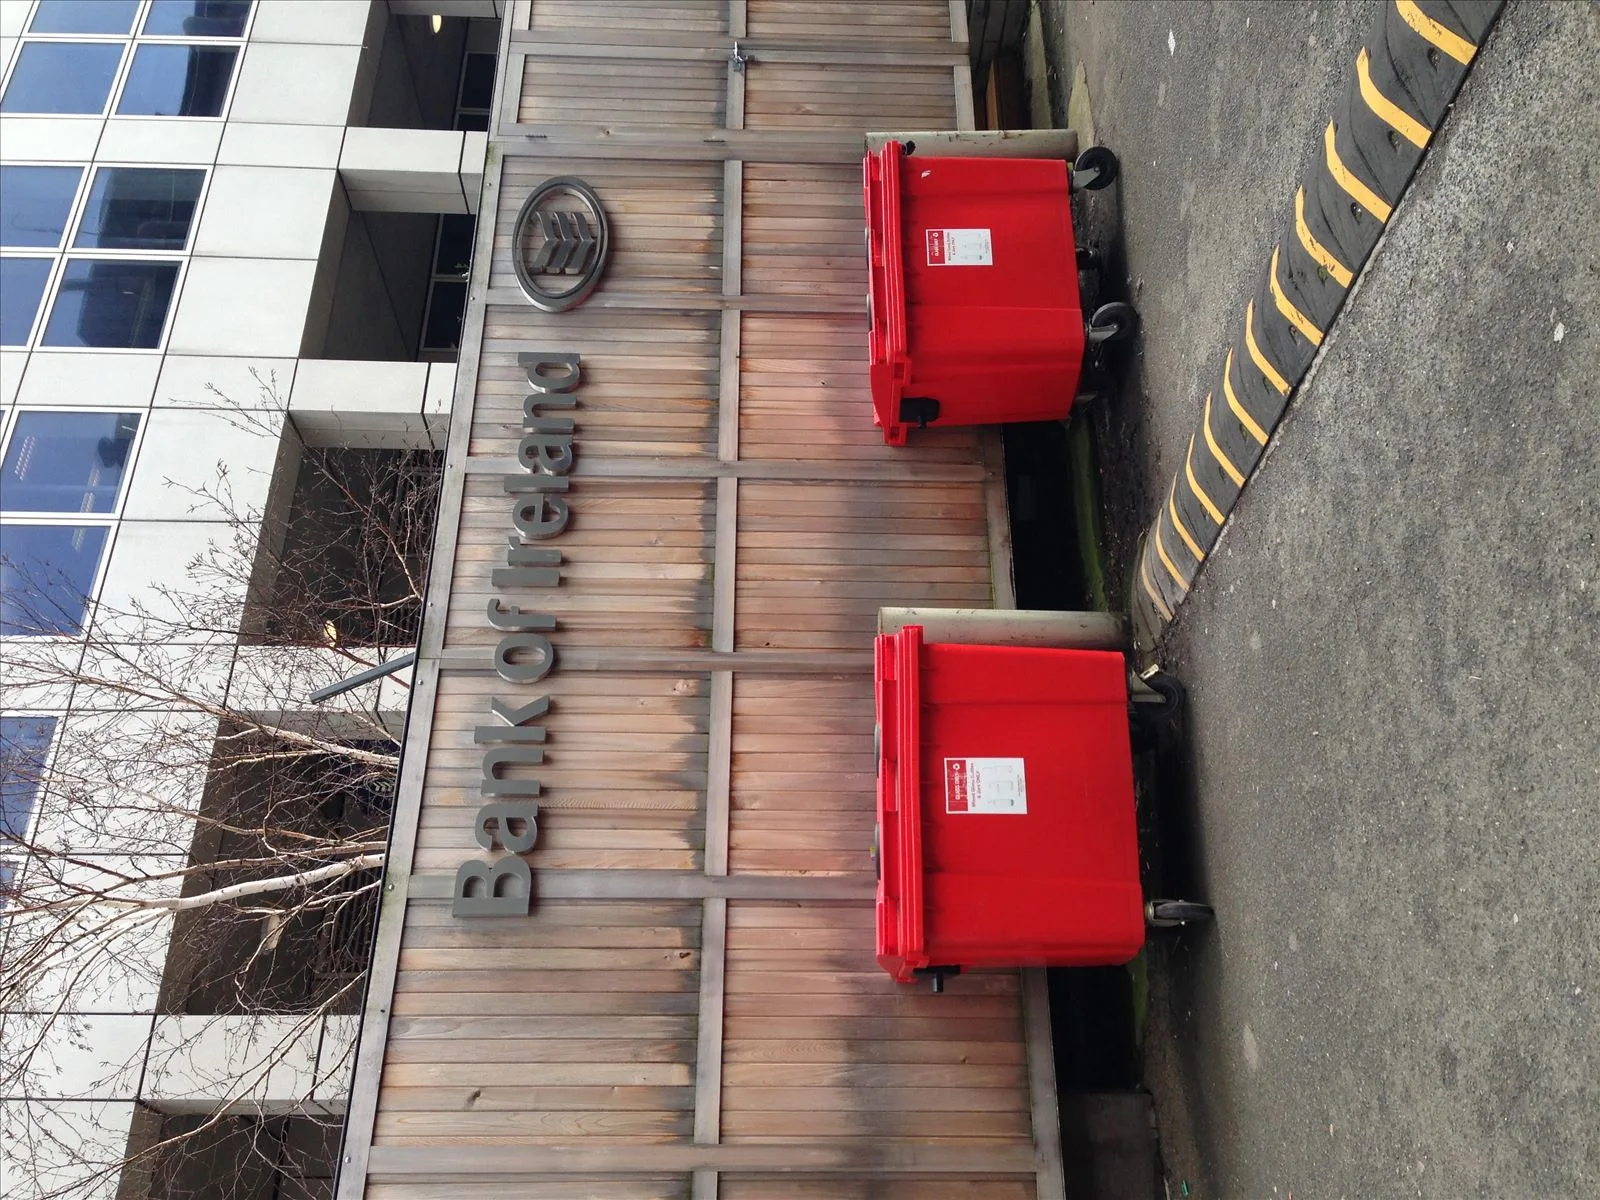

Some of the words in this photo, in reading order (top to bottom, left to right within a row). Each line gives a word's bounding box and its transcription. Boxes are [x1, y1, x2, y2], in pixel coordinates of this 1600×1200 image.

[490, 351, 581, 588] Ireland
[487, 598, 557, 684] of
[452, 695, 551, 919] Bank
